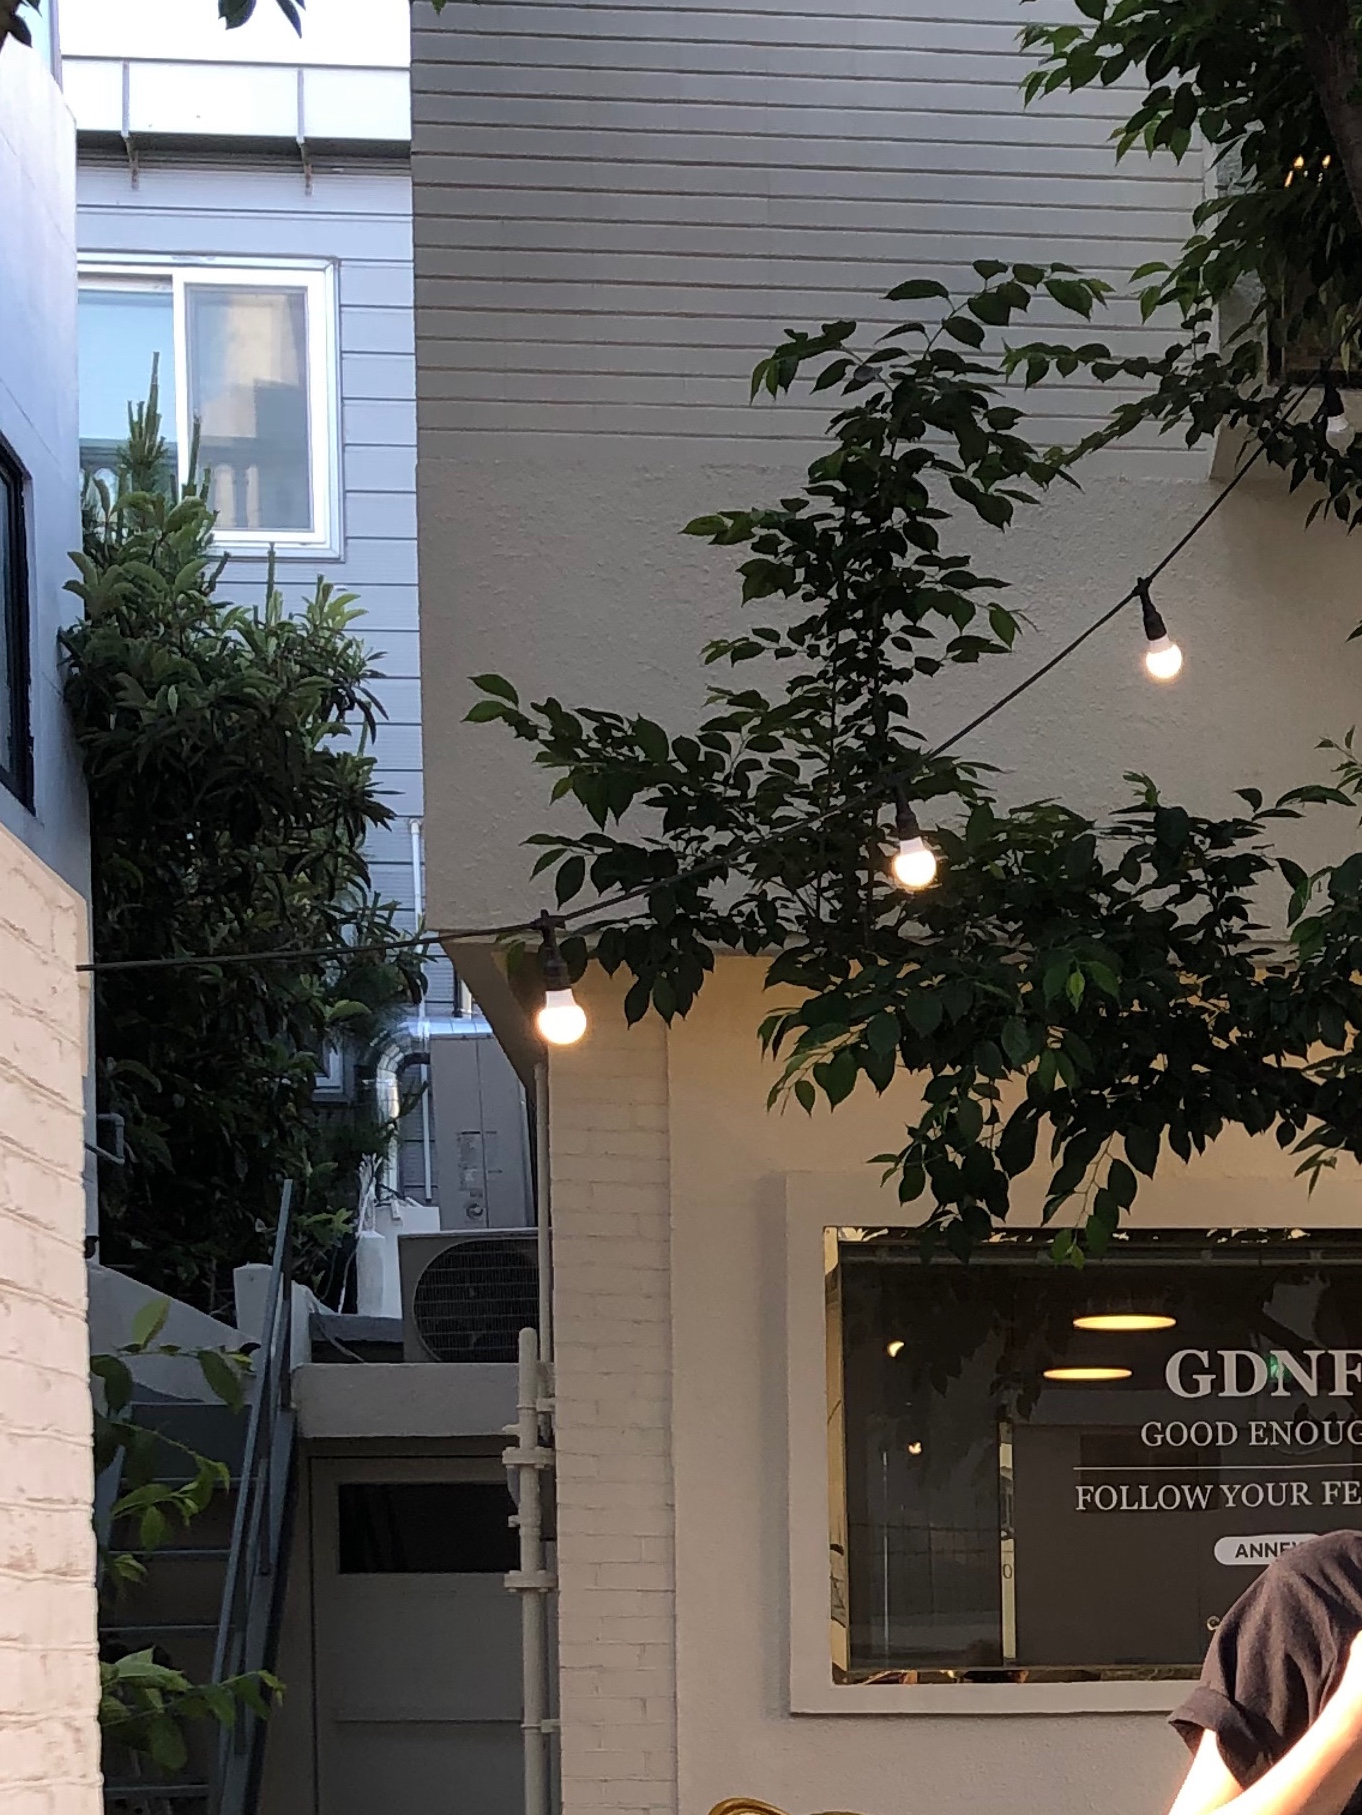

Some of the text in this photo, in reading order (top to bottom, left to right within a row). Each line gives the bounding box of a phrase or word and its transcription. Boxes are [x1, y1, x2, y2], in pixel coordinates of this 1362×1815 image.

[1140, 1421, 1238, 1447] GOOD
[1075, 1484, 1214, 1511] FOLLOW
[1219, 1481, 1313, 1508] YOUR
